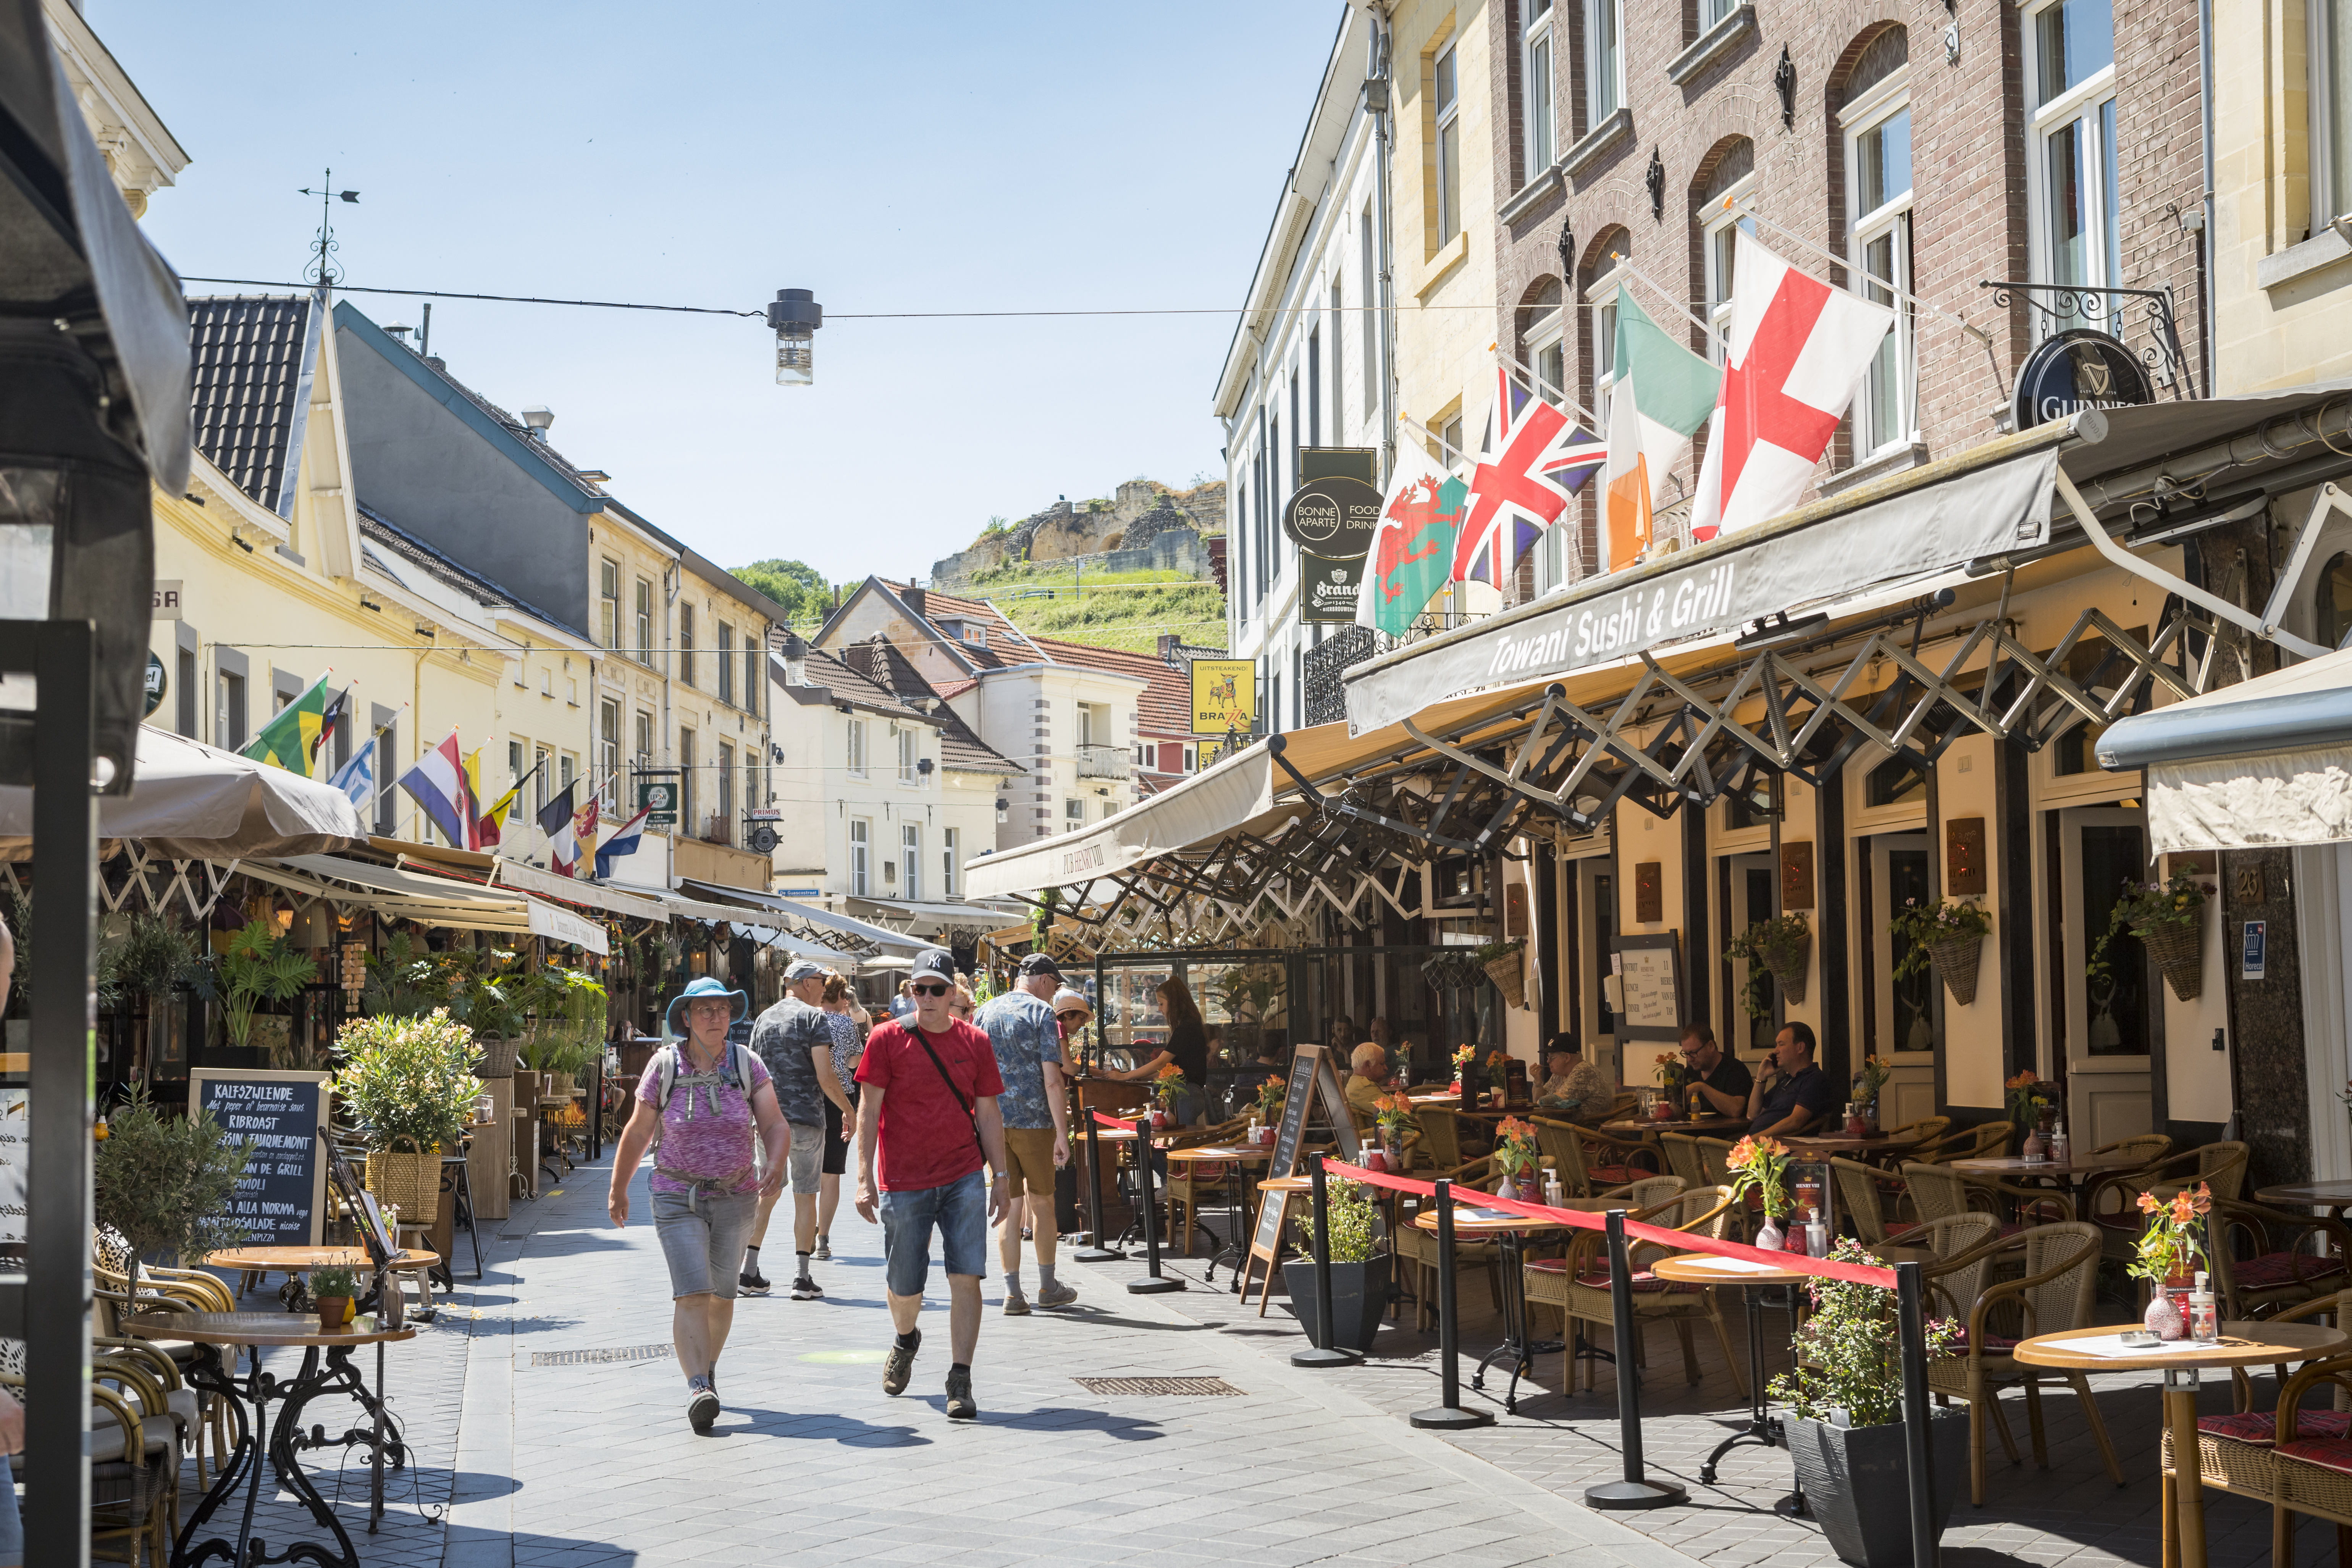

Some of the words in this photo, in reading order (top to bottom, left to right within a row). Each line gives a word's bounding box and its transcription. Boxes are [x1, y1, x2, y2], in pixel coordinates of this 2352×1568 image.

[1298, 507, 1336, 517] BONNE
[1350, 505, 1381, 515] FOOD
[1299, 518, 1336, 528] APARTE
[1317, 580, 1361, 597] Brand
[152, 591, 179, 608] SA
[1487, 614, 1572, 677] Towani
[1574, 591, 1643, 657] Sushi
[1646, 587, 1665, 638] &
[1671, 563, 1735, 628] Grill
[145, 670, 157, 683] el
[1200, 709, 1251, 731] BRAZZA
[1201, 753, 1213, 762] STE
[1064, 853, 1074, 875] PUB
[1074, 848, 1093, 872] HENRY
[1090, 844, 1104, 867] VIII
[2238, 869, 2259, 896] 26
[927, 954, 941, 968] NY
[1663, 960, 1669, 970] 11
[2245, 961, 2262, 971] Horeca
[1623, 963, 1638, 973] ONTBIJT
[1625, 983, 1639, 992] LUNCH
[1661, 992, 1669, 1000] VAN
[1670, 992, 1676, 1000] DE
[1628, 1004, 1640, 1012] DINER
[206, 1100, 221, 1110] Met
[224, 1102, 243, 1113] peper
[246, 1100, 255, 1111] of
[256, 1100, 287, 1112] bearnaise
[229, 1114, 280, 1130] RIBROAST
[240, 1163, 258, 1174] AN
[260, 1163, 272, 1175] DE
[277, 1163, 304, 1176] GRILL
[262, 1201, 295, 1216] NORMA
[296, 1208, 308, 1219] vega
